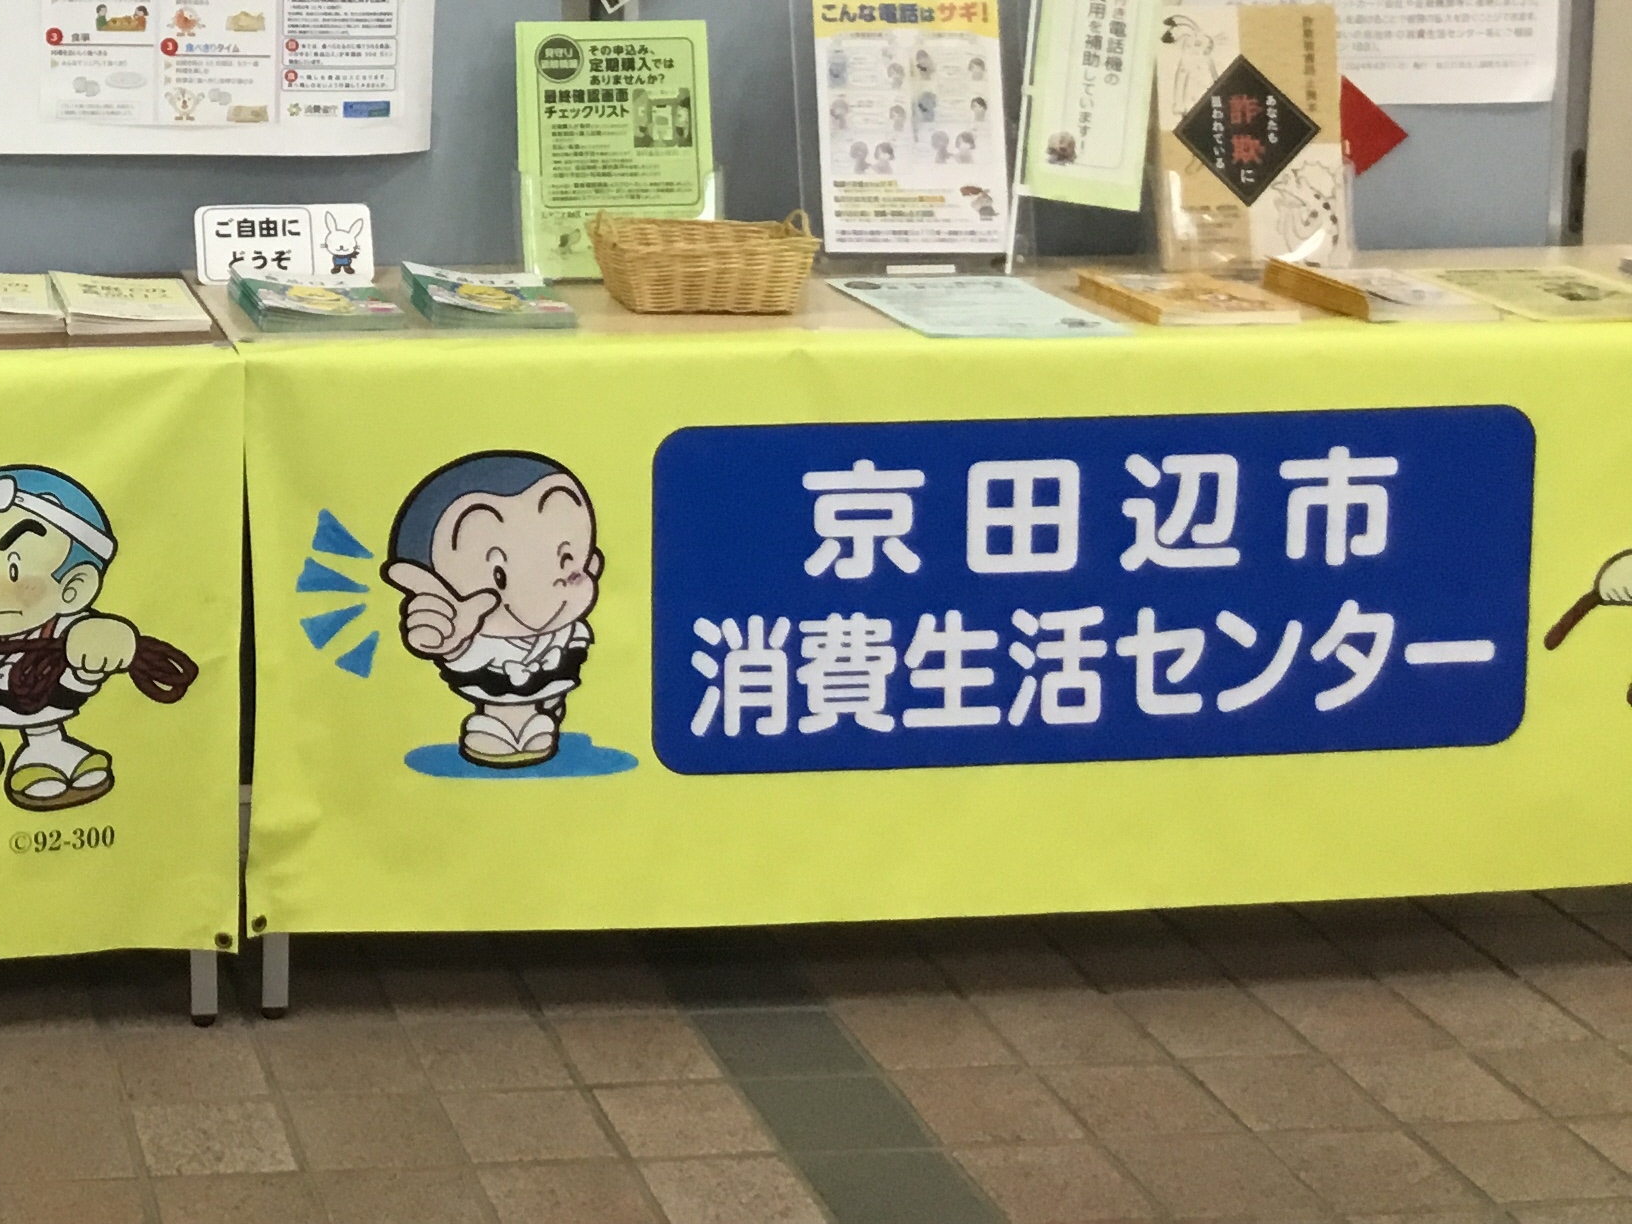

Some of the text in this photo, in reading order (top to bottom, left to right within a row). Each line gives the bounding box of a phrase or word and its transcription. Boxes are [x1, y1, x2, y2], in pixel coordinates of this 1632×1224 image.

[821, 2, 989, 24] こんな電話はサギ！
[589, 44, 655, 56] その申込み、
[589, 58, 674, 72] 定期購入では
[590, 74, 665, 86] ありませんか？
[544, 88, 629, 103] 最終確認画面
[544, 105, 630, 119] チェックリスト
[215, 217, 301, 238] ご自由に
[229, 250, 291, 270] どうぞ
[799, 446, 1400, 580] 京田辺市
[689, 599, 1497, 739] 消費生活センター
